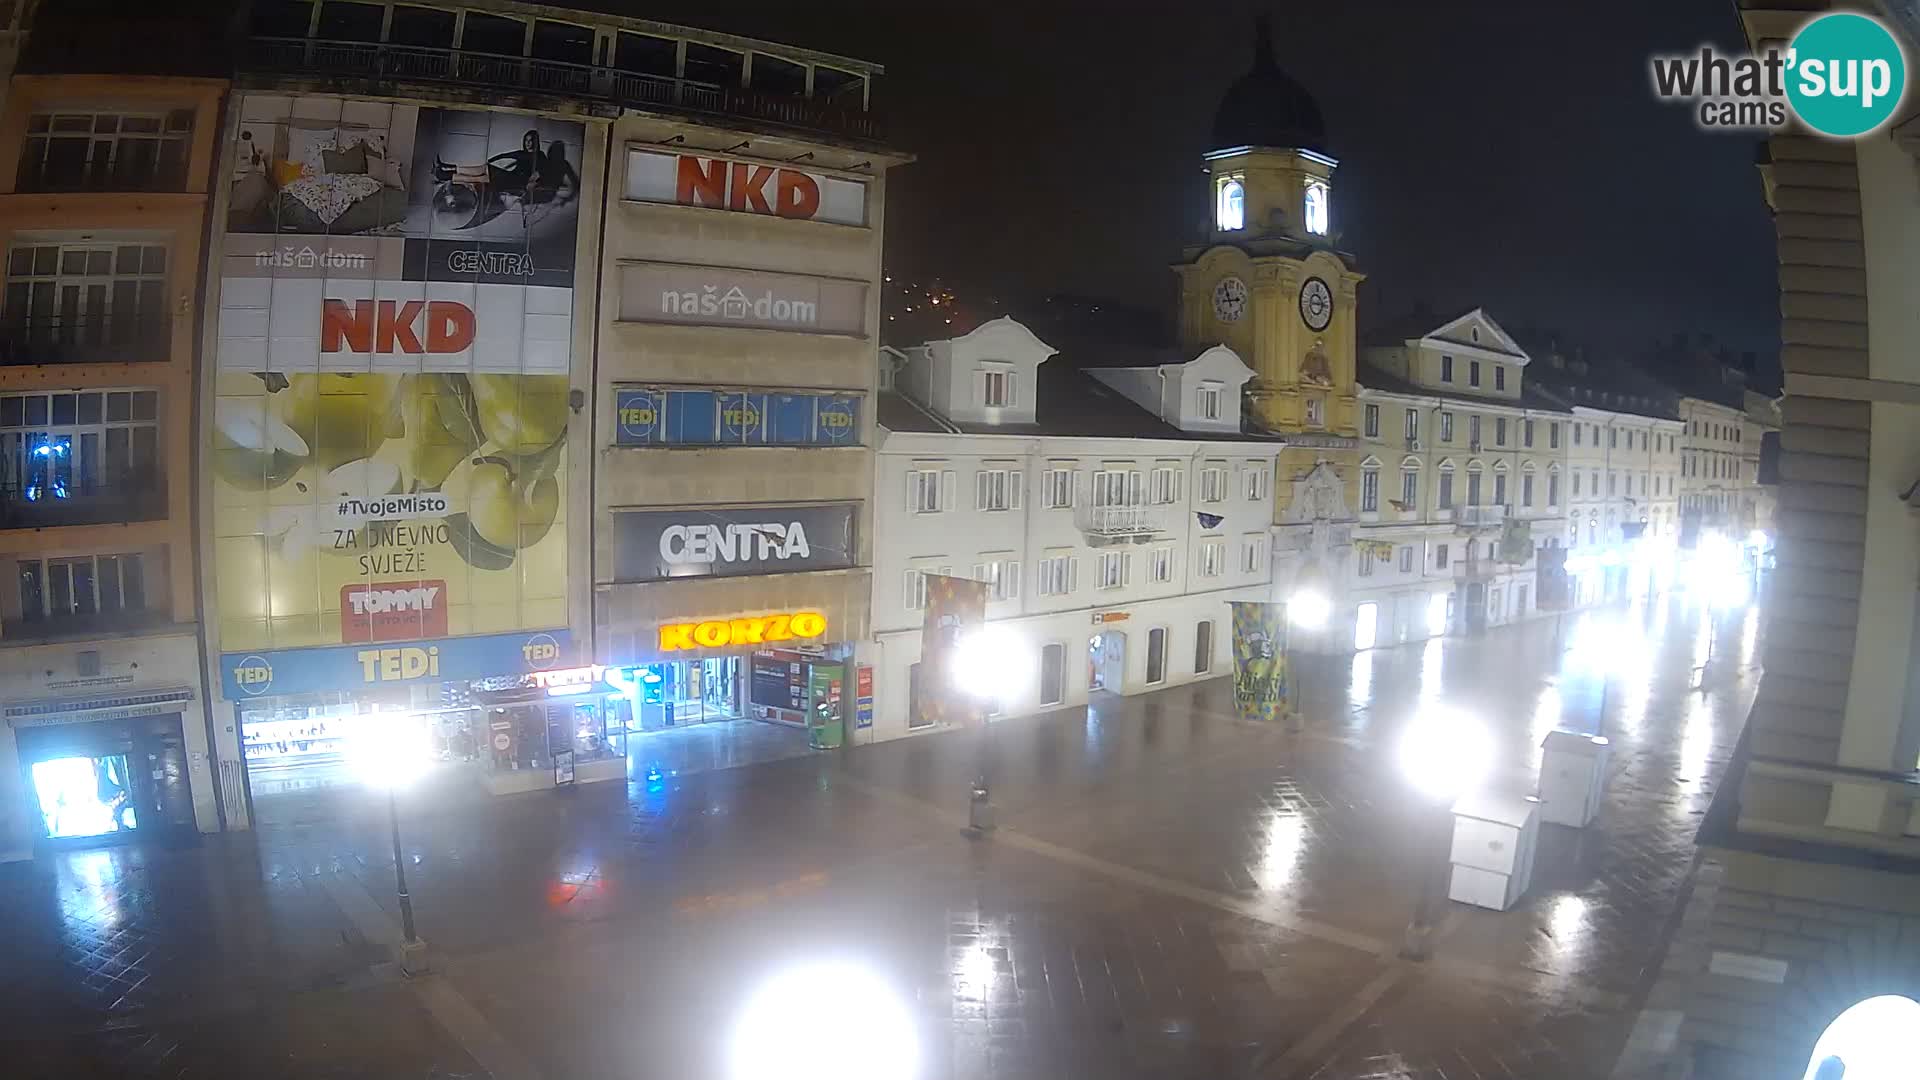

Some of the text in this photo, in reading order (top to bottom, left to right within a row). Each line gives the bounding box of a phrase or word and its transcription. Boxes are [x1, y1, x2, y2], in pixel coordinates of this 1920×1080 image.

[676, 154, 821, 219] NKD
[255, 245, 366, 270] naš dom
[447, 250, 536, 277] CENTRA
[662, 285, 817, 321] naš dom
[321, 298, 477, 354] NKD
[619, 408, 657, 425] TEDi
[723, 409, 760, 426] TEDi
[821, 411, 854, 428] TEDi
[338, 495, 446, 516] #TvojeMisto
[333, 523, 450, 549] ZA DNEVNO
[659, 521, 811, 565] CENTRA
[359, 548, 427, 576] SVJEŽE
[349, 587, 439, 615] TOMMY
[660, 613, 826, 651] KORZO
[233, 667, 273, 684] TEDi
[358, 646, 439, 682] TEDi
